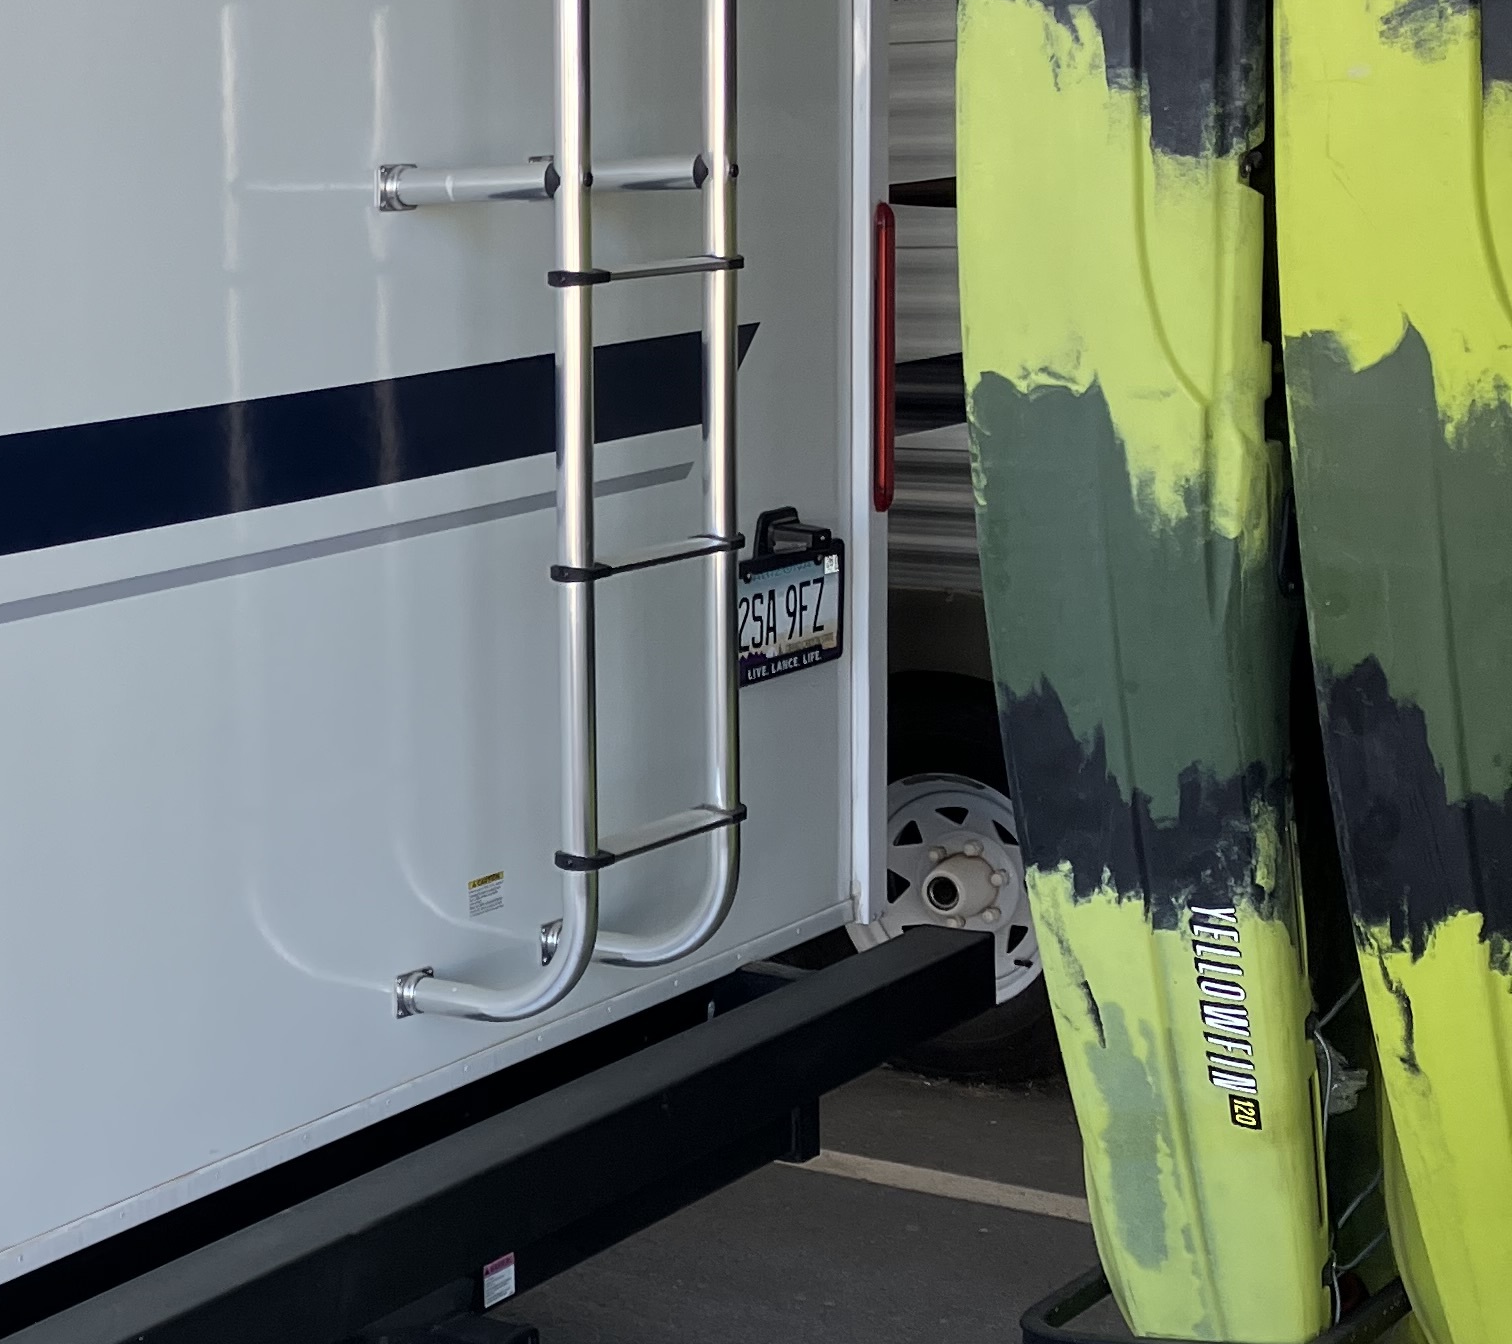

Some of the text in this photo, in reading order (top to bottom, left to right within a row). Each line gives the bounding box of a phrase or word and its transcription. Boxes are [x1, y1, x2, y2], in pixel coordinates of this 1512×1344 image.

[786, 576, 825, 641] 9FZ
[771, 656, 800, 674] LANCE.
[1190, 905, 1258, 1128] YELLOWFIN 120
